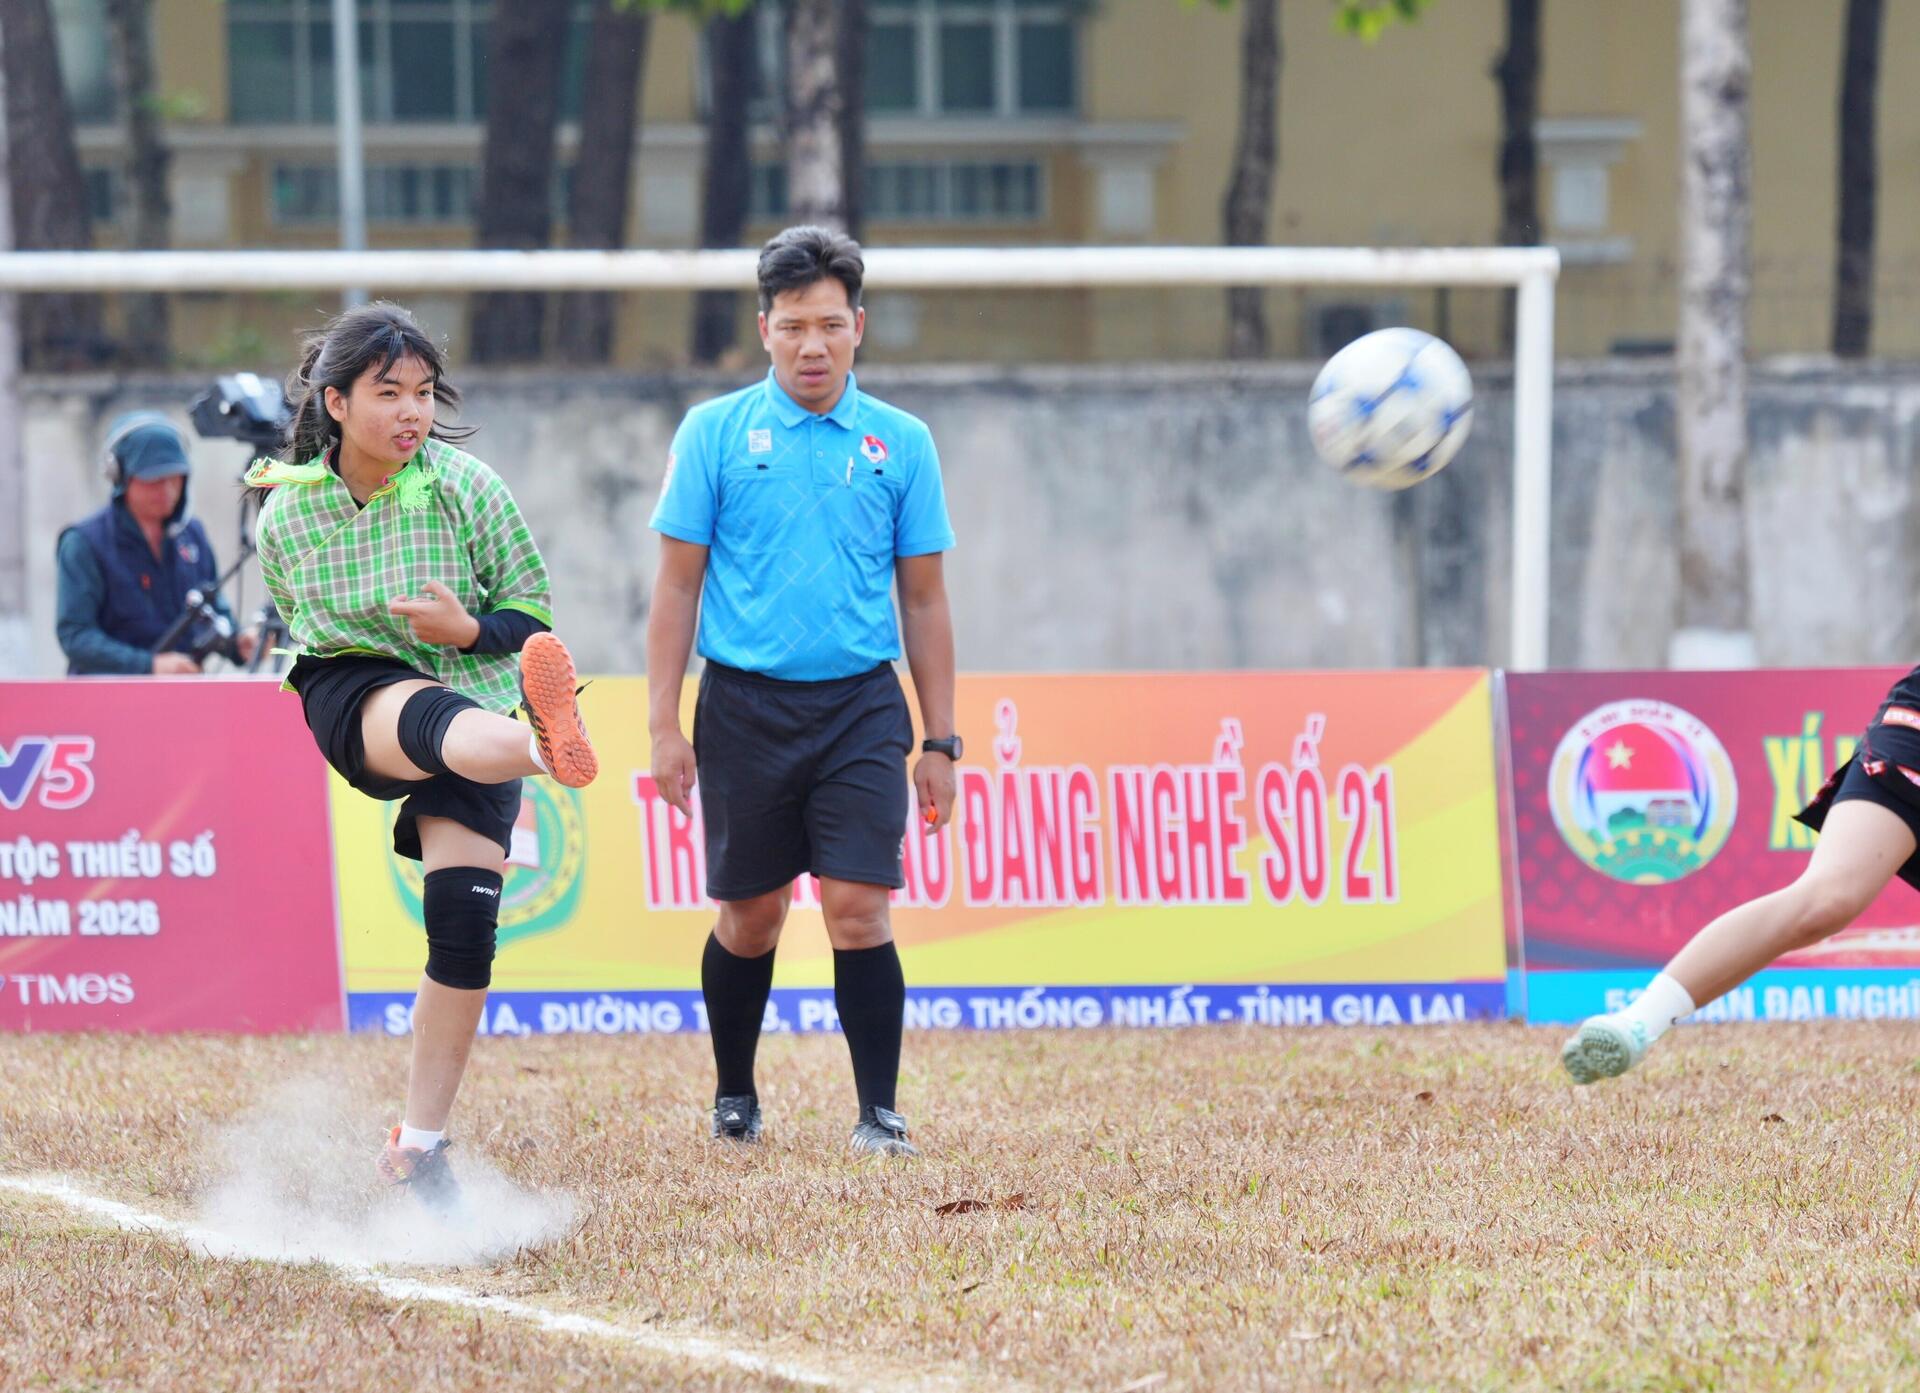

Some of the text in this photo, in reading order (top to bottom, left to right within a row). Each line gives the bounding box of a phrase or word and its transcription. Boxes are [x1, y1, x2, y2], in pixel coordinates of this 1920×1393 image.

[956, 699, 1105, 908] ĐẲNG
[1109, 717, 1251, 906] NGHỀ
[1257, 713, 1329, 906] SỐ
[1339, 765, 1400, 904] 21
[66, 828, 162, 878] THIỂU
[169, 829, 216, 878] SỐ
[0, 893, 160, 936] NĂM 2026
[385, 1002, 416, 1036] S
[540, 994, 683, 1033] ĐƯỜNG
[967, 987, 1104, 1029] THỐNG
[1111, 984, 1211, 1027] NHẤT
[1237, 985, 1324, 1026] TỈNH
[1331, 994, 1402, 1025] GIA
[1409, 992, 1467, 1025] LAI
